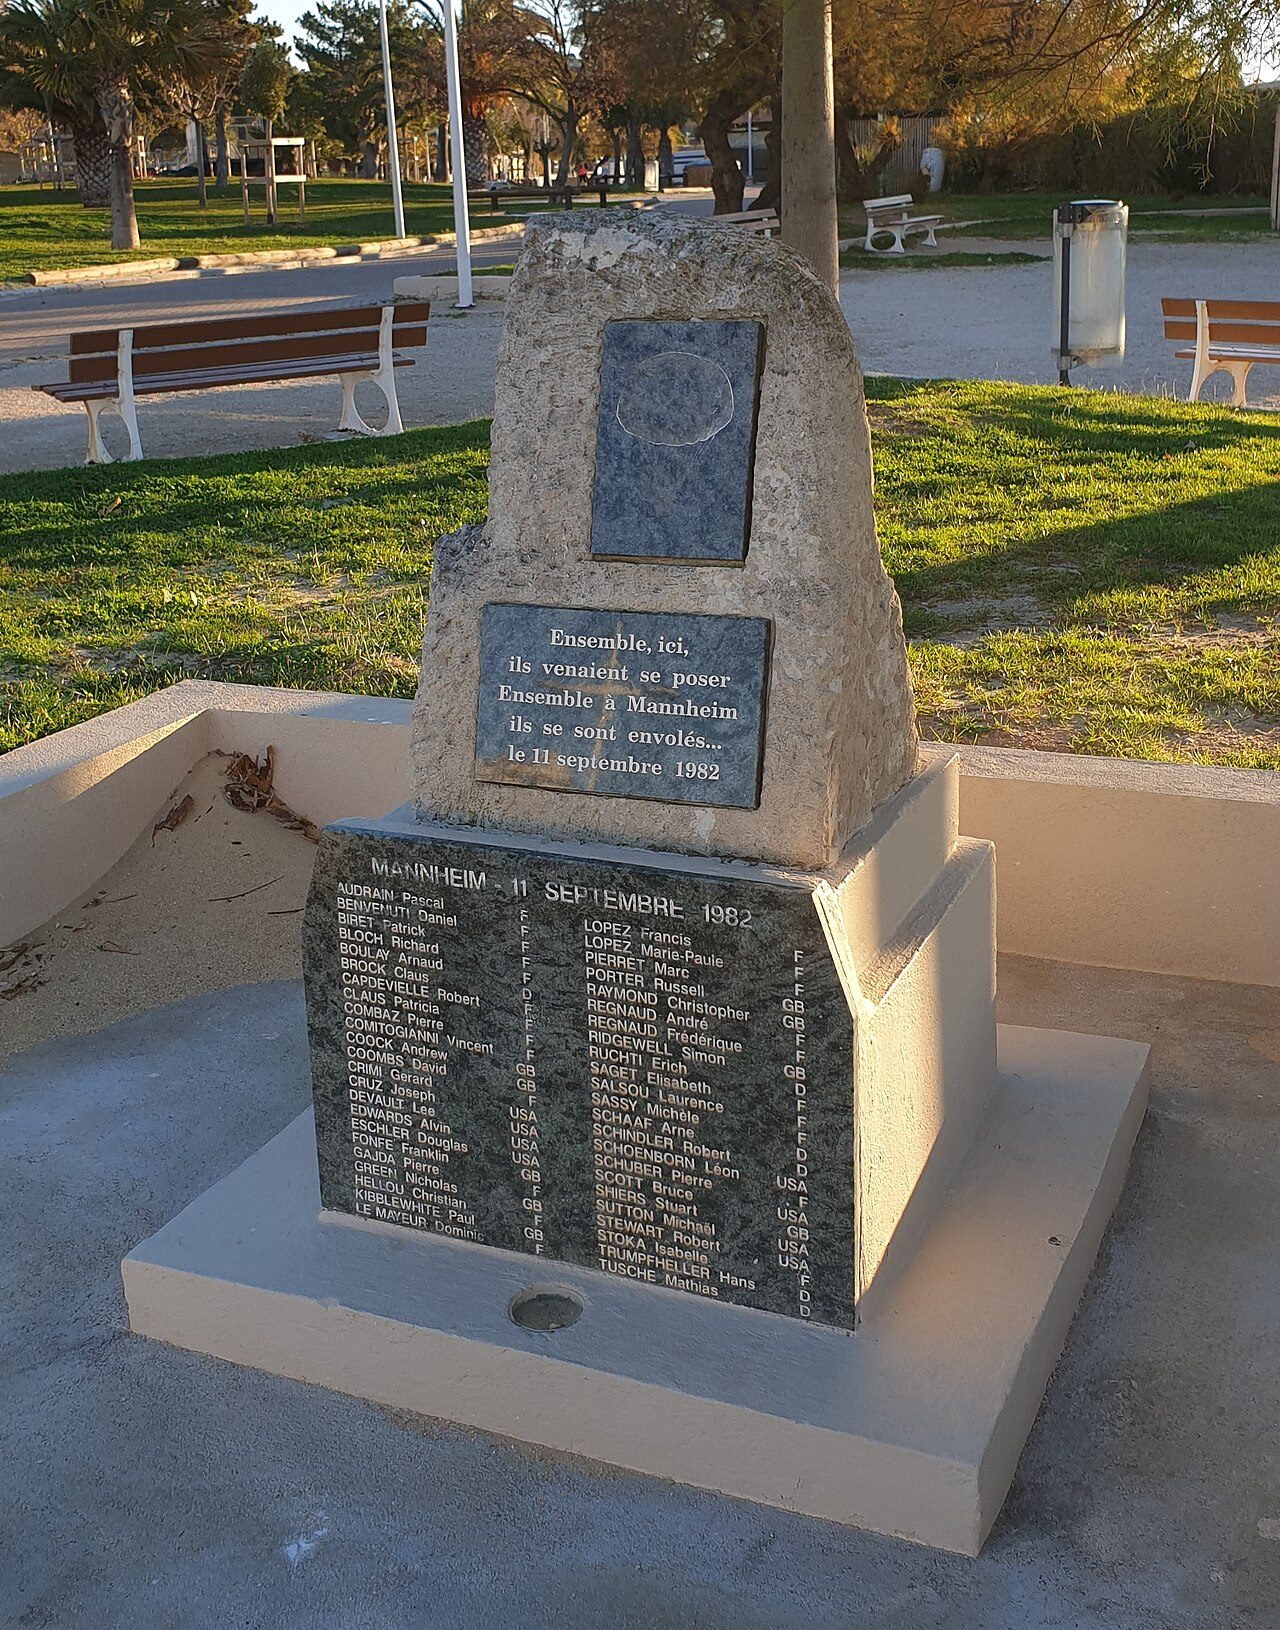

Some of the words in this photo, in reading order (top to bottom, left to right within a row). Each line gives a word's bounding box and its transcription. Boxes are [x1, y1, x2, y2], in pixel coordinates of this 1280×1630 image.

[550, 629, 651, 655] Ensemble,
[658, 636, 689, 657] ici,
[509, 656, 531, 674] ils
[542, 662, 628, 681] venaient
[640, 669, 661, 682] se
[672, 671, 730, 689] poser
[498, 685, 593, 709] Ensemble
[605, 694, 615, 710] à
[627, 696, 738, 720] Mannheim
[509, 716, 532, 733] ils
[543, 722, 562, 736] se
[574, 724, 616, 741] sont
[628, 730, 722, 750] envolés...
[508, 746, 525, 762] le
[532, 748, 550, 764] 11
[557, 752, 662, 775] septembre
[675, 761, 720, 780] 1982
[338, 882, 393, 901] AUDRAIN
[403, 893, 444, 909] Pascal
[338, 897, 410, 919] BENVENUTI
[419, 910, 456, 926] Daniel
[372, 857, 486, 889] MANNHEIM
[513, 878, 527, 896] 11
[545, 882, 684, 919] SEPTEMBRE
[702, 903, 752, 928] 1982
[338, 913, 373, 928] BIRET
[384, 920, 426, 936] Patrick
[339, 928, 383, 945] BLOCH
[392, 936, 439, 954] Richard
[585, 920, 631, 938] LOPEZ
[641, 927, 691, 946] Francis
[795, 951, 803, 962] F
[340, 942, 390, 961] BOULAY
[399, 953, 443, 970] Arnaud
[523, 973, 531, 984] F
[341, 958, 386, 974] BROCK
[394, 967, 429, 982] Claus
[523, 988, 531, 999] D
[585, 935, 631, 953] LOPEZ
[641, 944, 724, 968] Marie-Paule
[795, 967, 803, 979] F
[586, 951, 645, 971] PIERRET
[654, 962, 689, 979] Marc
[795, 984, 804, 996] F
[342, 972, 429, 997] CAPDEVIELLE
[438, 989, 480, 1006] Robert
[344, 987, 385, 1005] CLAUS
[394, 997, 439, 1014] Patricia
[586, 967, 644, 987] PORTER
[654, 978, 704, 997] Russell
[783, 999, 804, 1014] GB
[587, 983, 657, 1005] RAYMOND
[668, 997, 749, 1022] Christopher
[783, 1016, 805, 1030] GB
[344, 1002, 400, 1021] COMBAZ
[408, 1014, 443, 1030] Pierre
[526, 1035, 533, 1045] F
[345, 1017, 438, 1044] COMITOGIANNI
[447, 1035, 493, 1054] Vincent
[527, 1051, 534, 1061] F
[588, 999, 657, 1021] REGNAUD
[666, 1012, 708, 1030] André
[796, 1035, 805, 1046] F
[588, 1015, 657, 1037] REGNAUD
[668, 1029, 742, 1053] Frédérique
[796, 1051, 805, 1062] F
[346, 1032, 394, 1050] COOCK
[402, 1043, 448, 1060] Andrew
[516, 1063, 535, 1076] GB
[347, 1047, 404, 1066] COOMBS
[413, 1059, 446, 1075] David
[517, 1079, 536, 1092] GB
[589, 1030, 672, 1056] RIDGEWELL
[682, 1047, 725, 1066] Simon
[784, 1065, 806, 1080] GB
[590, 1046, 642, 1066] RUCHTI
[652, 1057, 687, 1074] Erich
[796, 1083, 806, 1095] D
[348, 1061, 382, 1077] CRIMI
[391, 1070, 433, 1087] Gerard
[529, 1096, 536, 1106] F
[349, 1075, 383, 1092] CRUZ
[391, 1084, 435, 1102] Joseph
[510, 1107, 537, 1122] USA
[591, 1062, 637, 1080] SAGET
[647, 1073, 711, 1095] Elisabeth
[797, 1100, 806, 1111] F
[591, 1077, 649, 1099] SALSOU
[659, 1090, 724, 1113] Laurence
[798, 1116, 806, 1128] F
[350, 1090, 403, 1108] DEVAULT
[412, 1103, 435, 1117] Lee
[511, 1122, 538, 1137] USA
[351, 1104, 412, 1126] EDWARDS
[421, 1119, 450, 1134] Alvin
[511, 1137, 539, 1152] USA
[591, 1092, 637, 1112] SASSY
[647, 1105, 699, 1124] Michèle
[351, 1118, 409, 1139] ESCHLER
[418, 1132, 468, 1153] Douglas
[512, 1152, 540, 1167] USA
[592, 1108, 652, 1129] SCHAAF
[661, 1123, 694, 1139] Arne
[796, 1148, 807, 1160] D
[592, 1123, 673, 1150] SCHINDLER
[683, 1142, 731, 1162] Robert
[797, 1165, 807, 1177] D
[353, 1147, 396, 1165] GAJDA
[404, 1158, 439, 1174] Pierre
[533, 1185, 541, 1196] F
[354, 1161, 397, 1178] GREEN
[405, 1172, 457, 1193] Nicholas
[522, 1199, 542, 1211] GB
[402, 1144, 449, 1162] Franklin
[521, 1169, 541, 1182] GB
[594, 1139, 694, 1169] SCHOENBORN
[705, 1162, 739, 1179] Léon
[776, 1176, 807, 1192] USA
[594, 1154, 662, 1178] SCHUBER
[672, 1170, 712, 1189] Pierre
[355, 1176, 404, 1195] HELLOU
[412, 1188, 467, 1210] Christian
[355, 1190, 440, 1217] KIBBLEWHITE
[449, 1210, 475, 1225] Paul
[524, 1227, 543, 1240] GB
[595, 1170, 643, 1189] SCOTT
[653, 1183, 693, 1200] Bruce
[777, 1208, 808, 1224] USA
[595, 1185, 646, 1204] SHIERS
[655, 1197, 698, 1216] Stuart
[787, 1226, 809, 1240] GB
[356, 1203, 370, 1215] LE
[376, 1206, 427, 1228] MAYEUR
[536, 1244, 544, 1254] F
[596, 1200, 653, 1221] SUTTON
[664, 1215, 715, 1236] Michaël
[778, 1239, 809, 1255] USA
[597, 1215, 664, 1238] STEWART
[674, 1231, 720, 1251] Robert
[778, 1256, 809, 1272] USA
[597, 1229, 646, 1250] STOKA
[655, 1242, 708, 1264] Isabelle
[598, 1244, 710, 1279] TRUMPFHELLER
[720, 1271, 755, 1289] Hans
[799, 1290, 810, 1302] D
[599, 1259, 656, 1282] TUSCHE
[665, 1275, 718, 1297] Mathias
[800, 1305, 810, 1317] D
